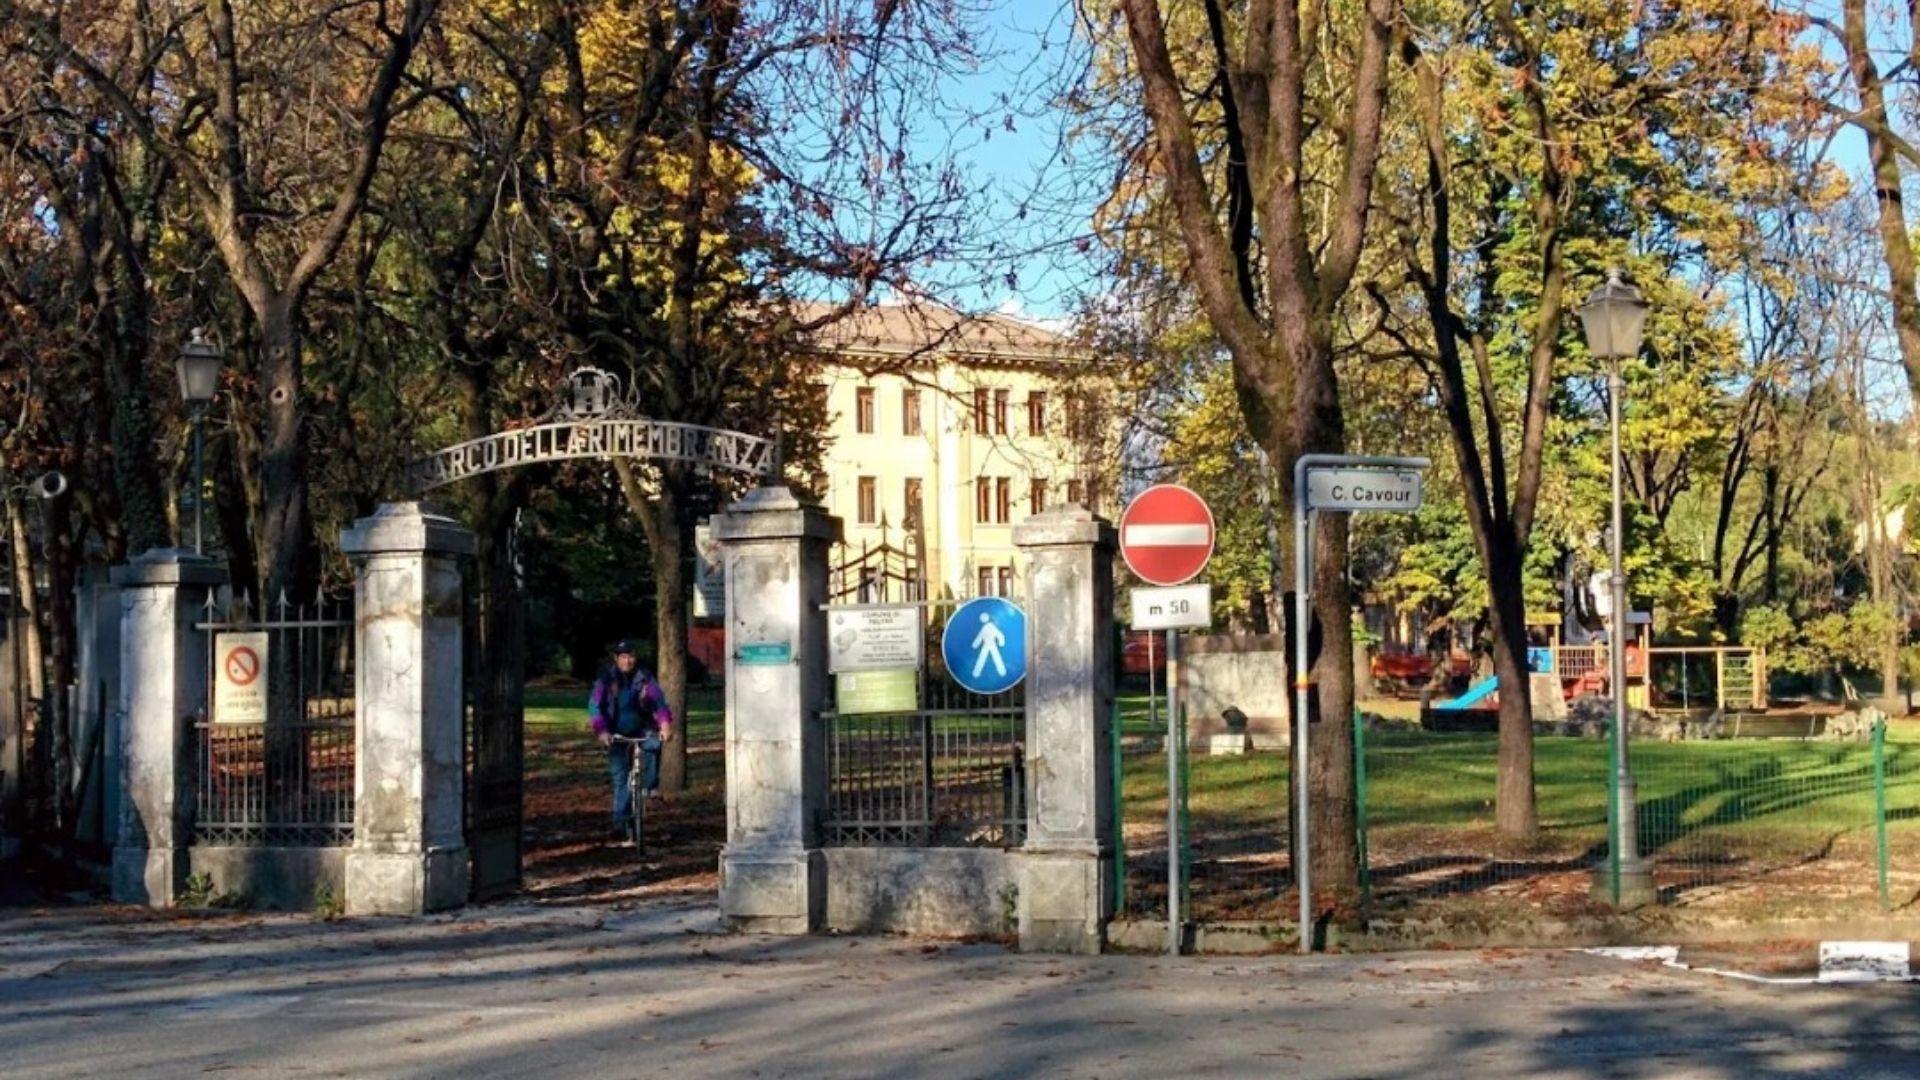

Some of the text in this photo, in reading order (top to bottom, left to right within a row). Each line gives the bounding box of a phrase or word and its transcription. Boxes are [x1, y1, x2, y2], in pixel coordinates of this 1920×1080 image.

[424, 423, 775, 487] ARCO DELLA RIMEMBRANZA
[1331, 485, 1411, 501] C. Cavour
[1149, 599, 1190, 616] m 50
